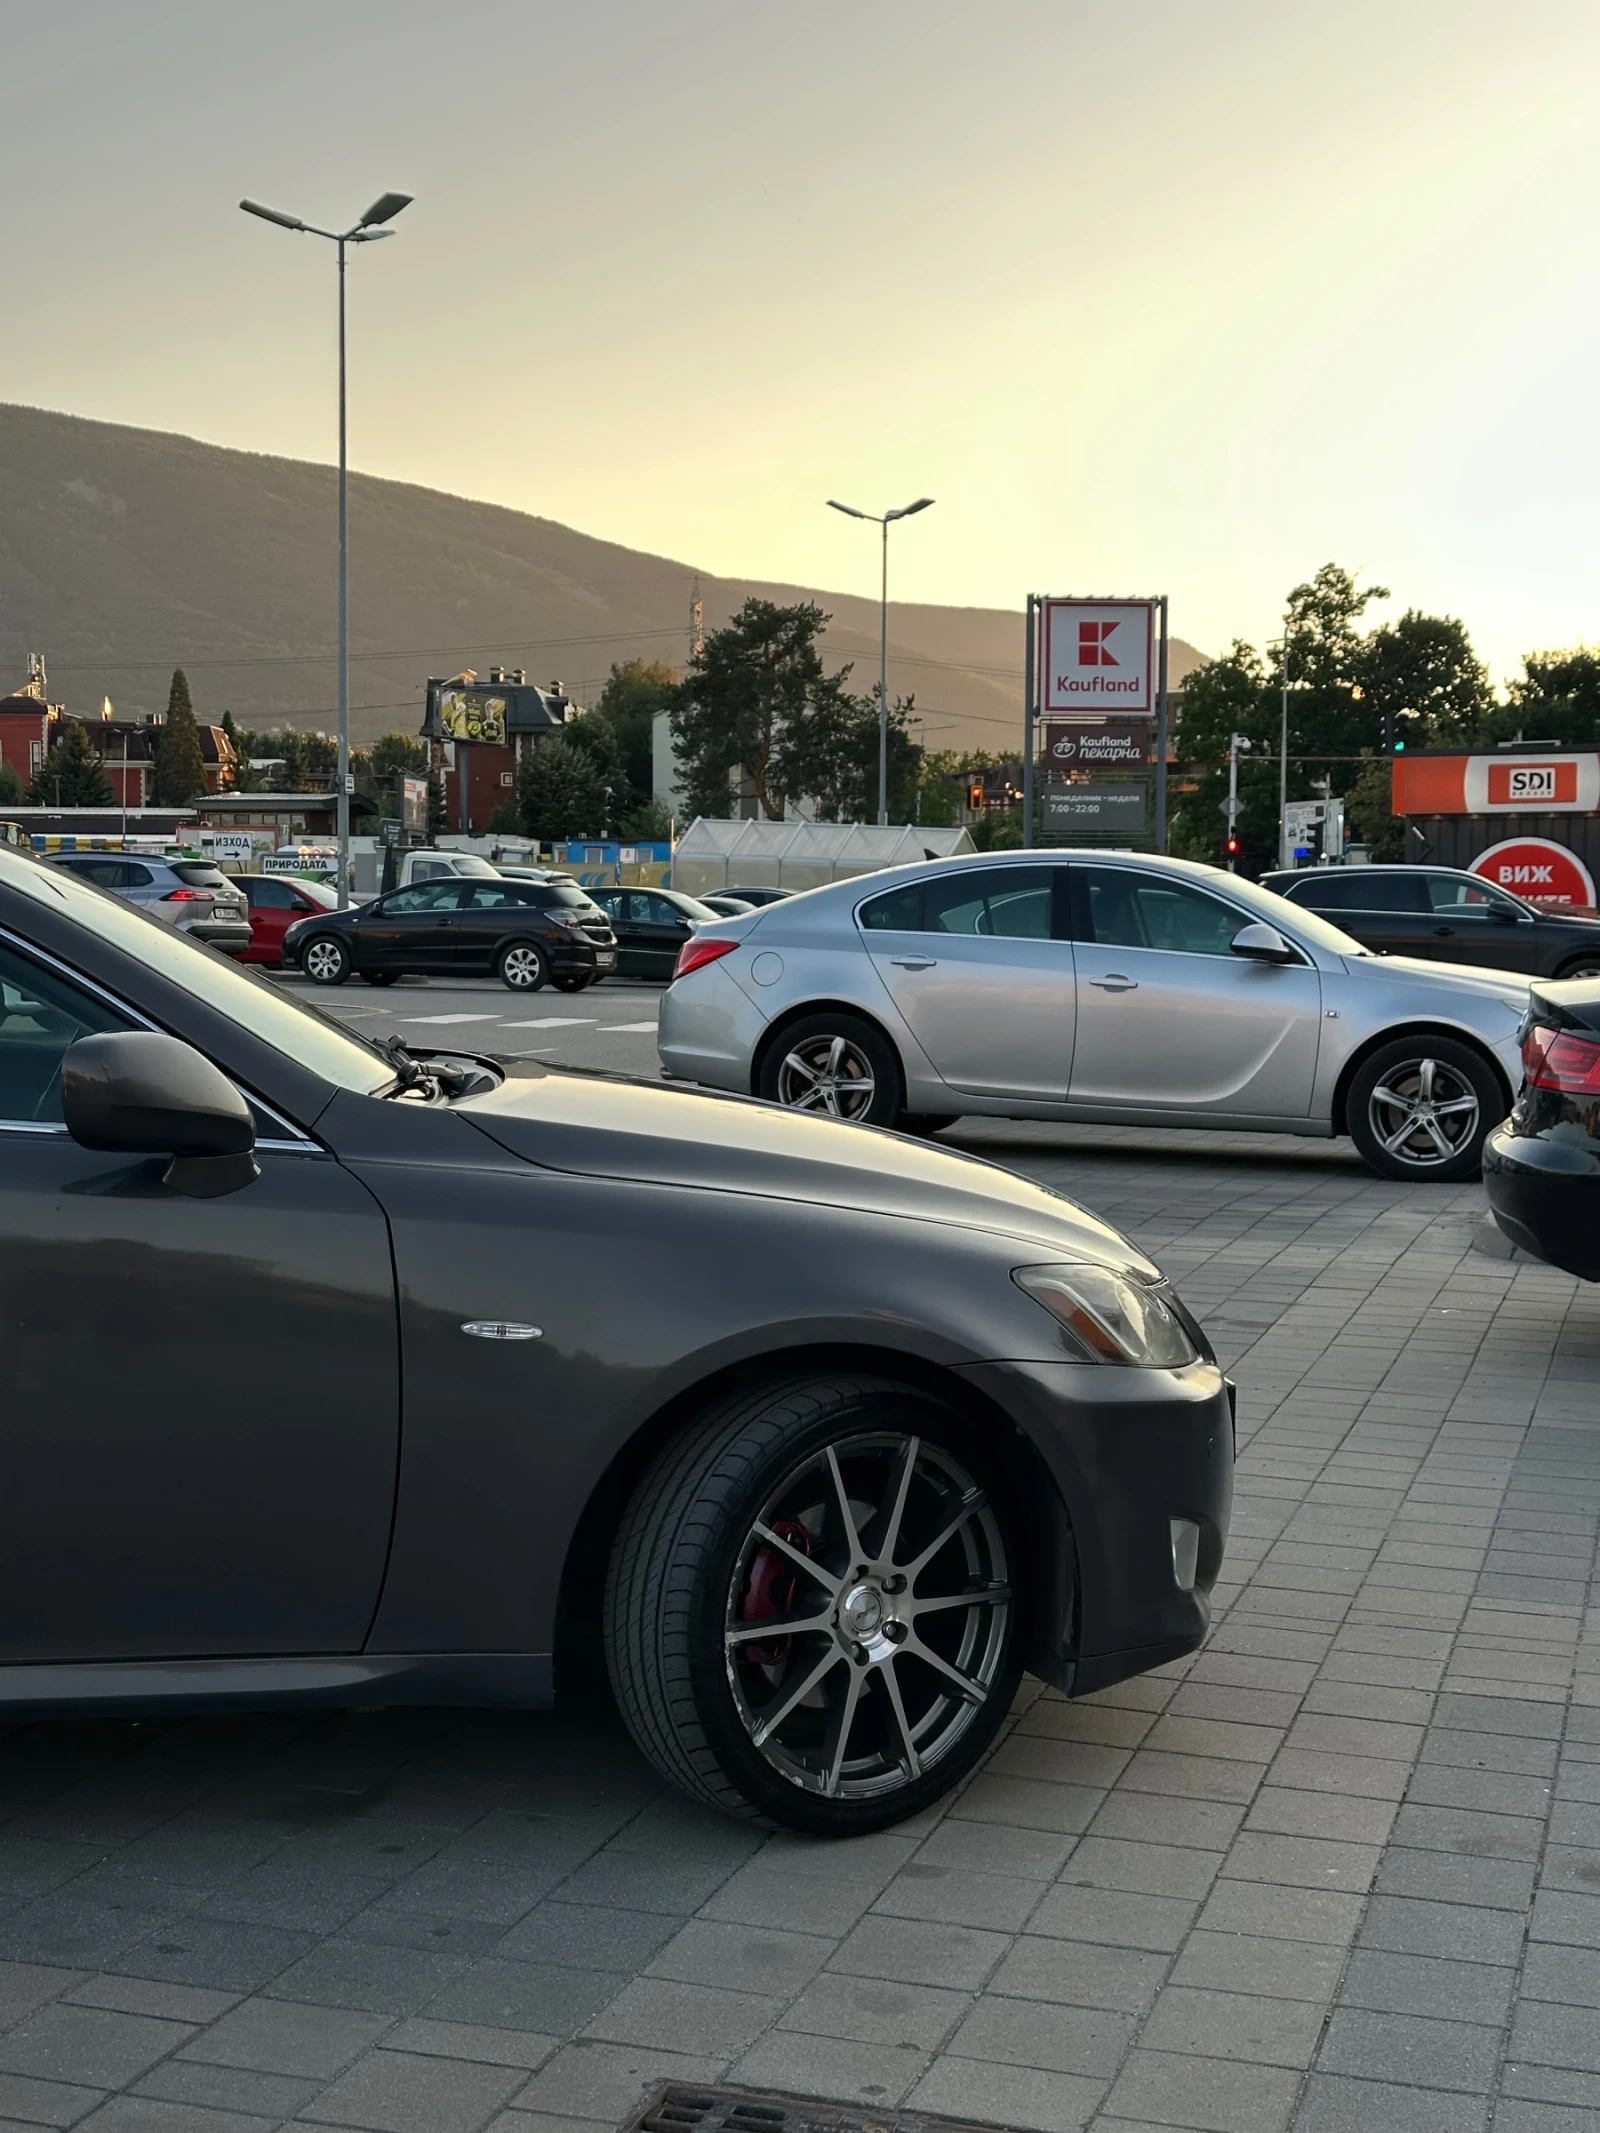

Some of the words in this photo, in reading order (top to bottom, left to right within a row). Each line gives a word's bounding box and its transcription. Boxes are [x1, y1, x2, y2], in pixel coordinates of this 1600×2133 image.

[1078, 621, 1121, 666] K
[1057, 675, 1140, 692] Kaufland
[1080, 736, 1131, 747] Kaufland
[1079, 747, 1141, 761] пекарна
[1513, 771, 1552, 790] SDI
[215, 837, 250, 849] ИЗХОД
[265, 860, 328, 870] ПРИРОДАТА
[1498, 864, 1554, 883] ВИЖ
